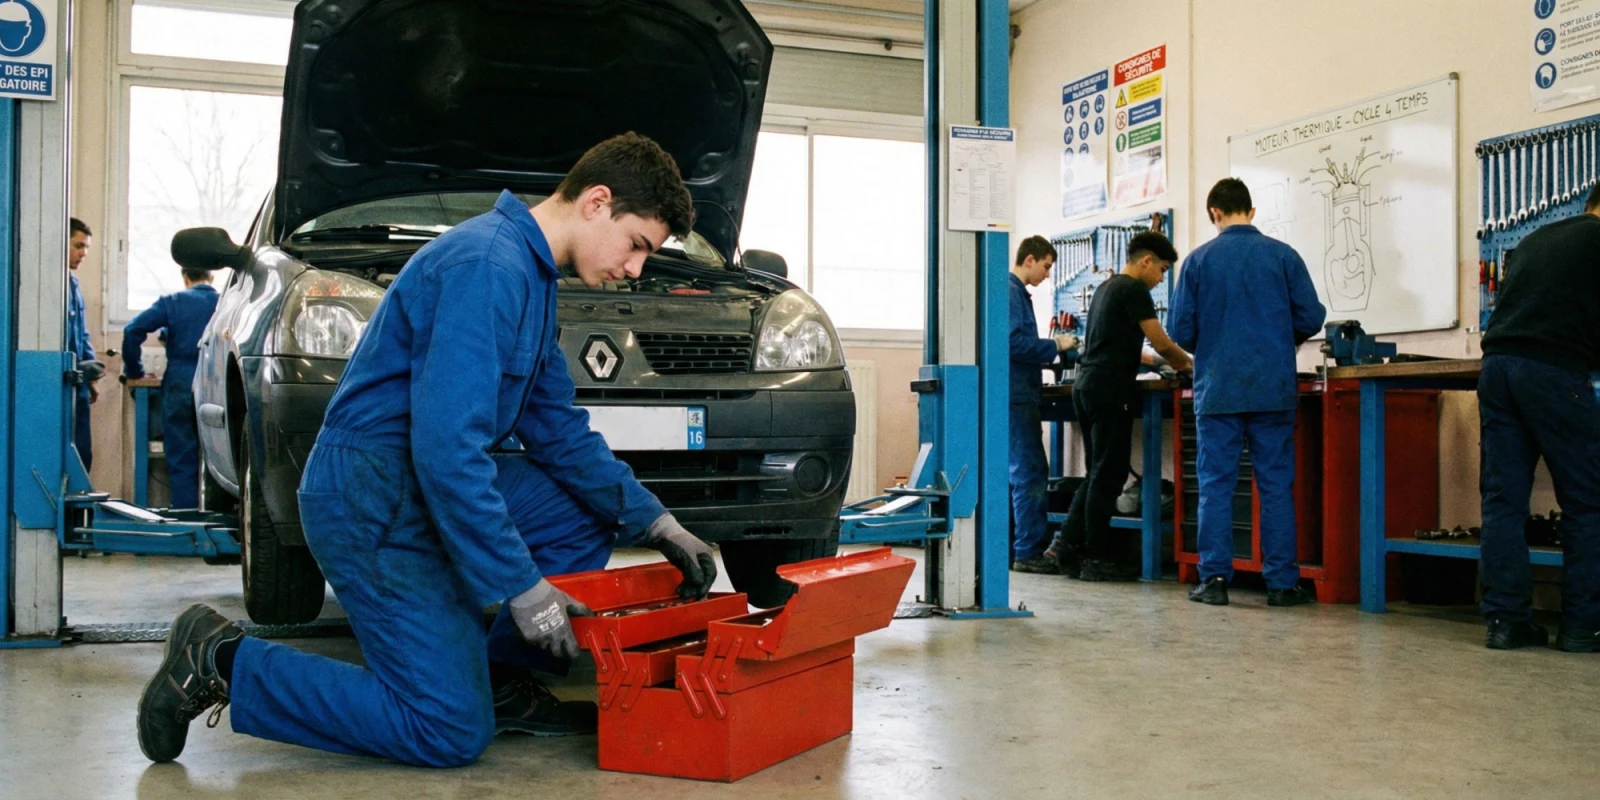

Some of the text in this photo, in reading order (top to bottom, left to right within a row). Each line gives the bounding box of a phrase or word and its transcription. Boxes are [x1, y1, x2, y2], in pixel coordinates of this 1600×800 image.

[1152, 48, 1161, 60] DE
[5, 65, 48, 78] DES EPI
[1255, 130, 1289, 153] MOTEUR
[1293, 115, 1342, 141] THERMIQUE
[1353, 104, 1381, 124] CYCLE
[1385, 103, 1392, 118] 4
[1395, 91, 1428, 112] TEMPS
[689, 430, 703, 445] 16
